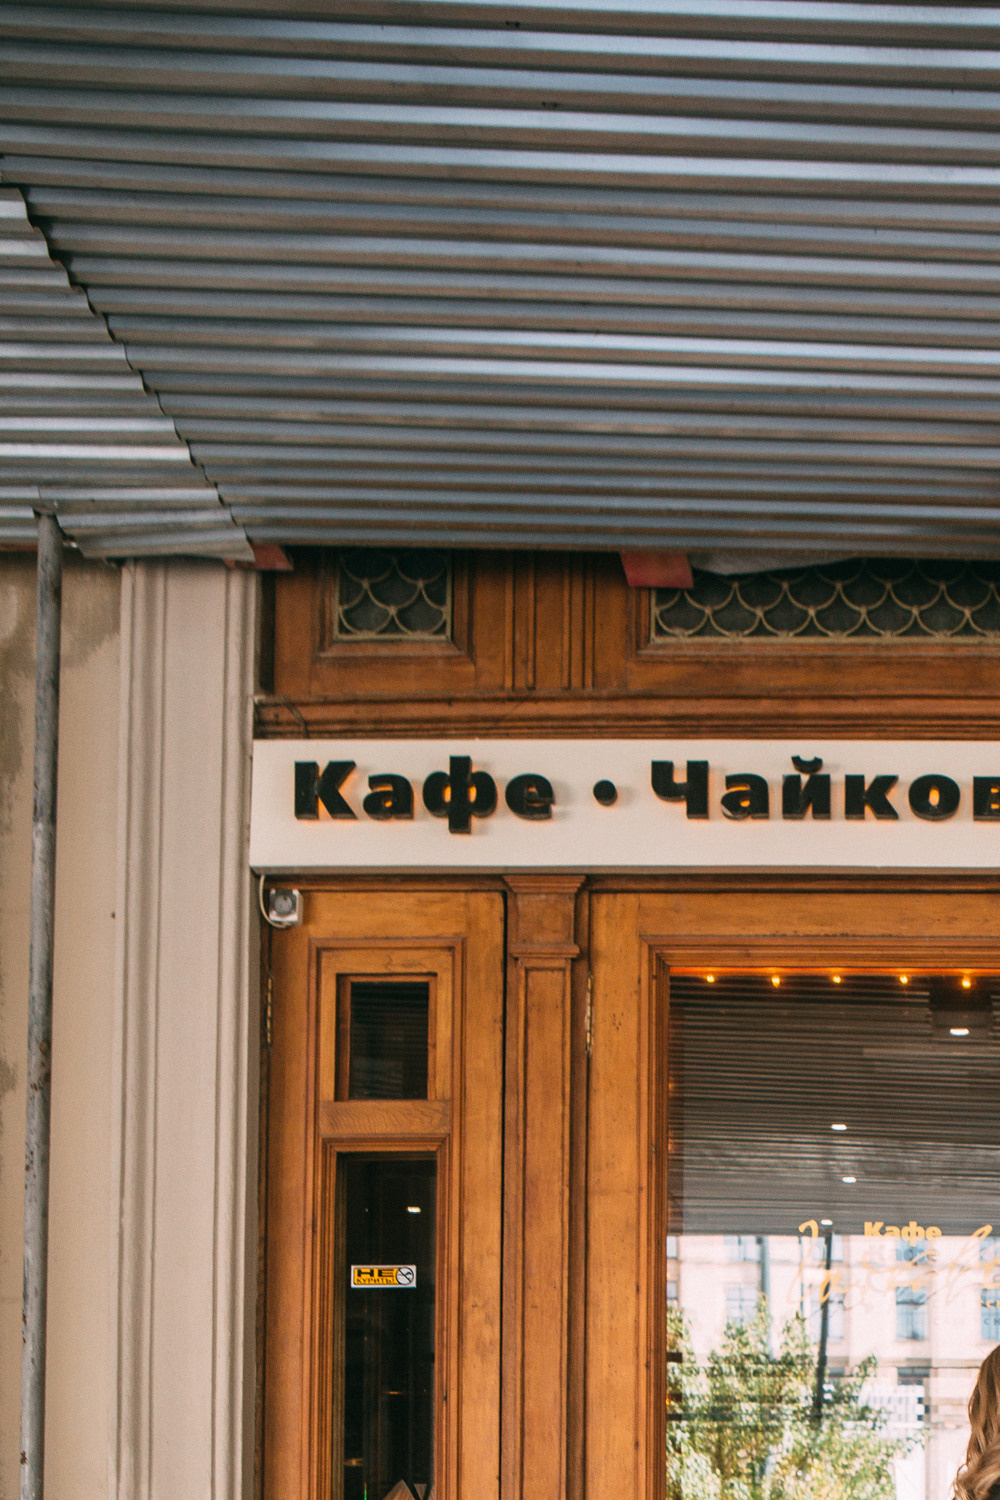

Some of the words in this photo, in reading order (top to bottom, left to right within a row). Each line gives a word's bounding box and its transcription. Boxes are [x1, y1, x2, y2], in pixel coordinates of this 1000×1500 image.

[294, 755, 554, 834] Кафе
[863, 1221, 943, 1247] Кафе
[357, 1269, 394, 1277] НЕ
